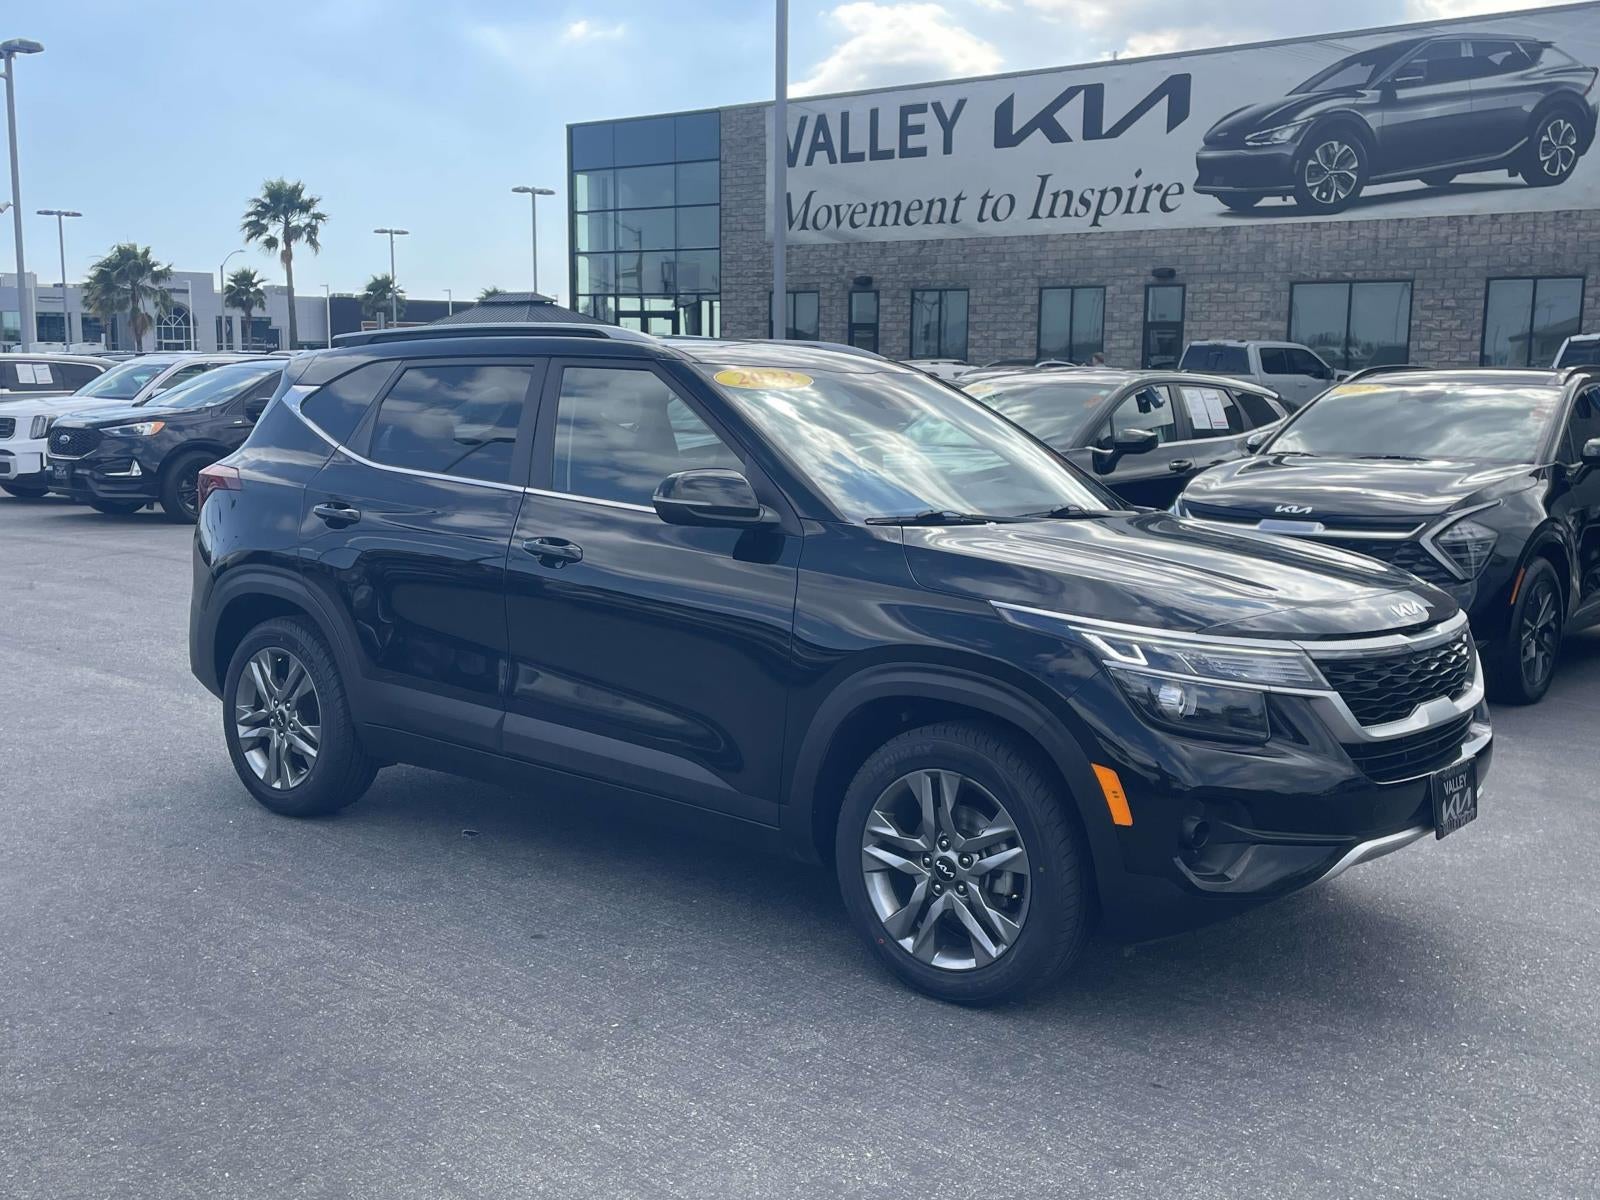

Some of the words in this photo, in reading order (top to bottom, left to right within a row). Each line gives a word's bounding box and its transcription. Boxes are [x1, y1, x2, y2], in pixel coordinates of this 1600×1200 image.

[786, 98, 968, 168] VALLEY
[994, 73, 1192, 149] KIA
[786, 189, 968, 232] Movement
[976, 187, 1017, 224] to
[1027, 168, 1185, 228] Inspire
[1275, 504, 1313, 514] KIA
[1443, 772, 1467, 796] VALLEY
[1442, 786, 1472, 823] KIA
